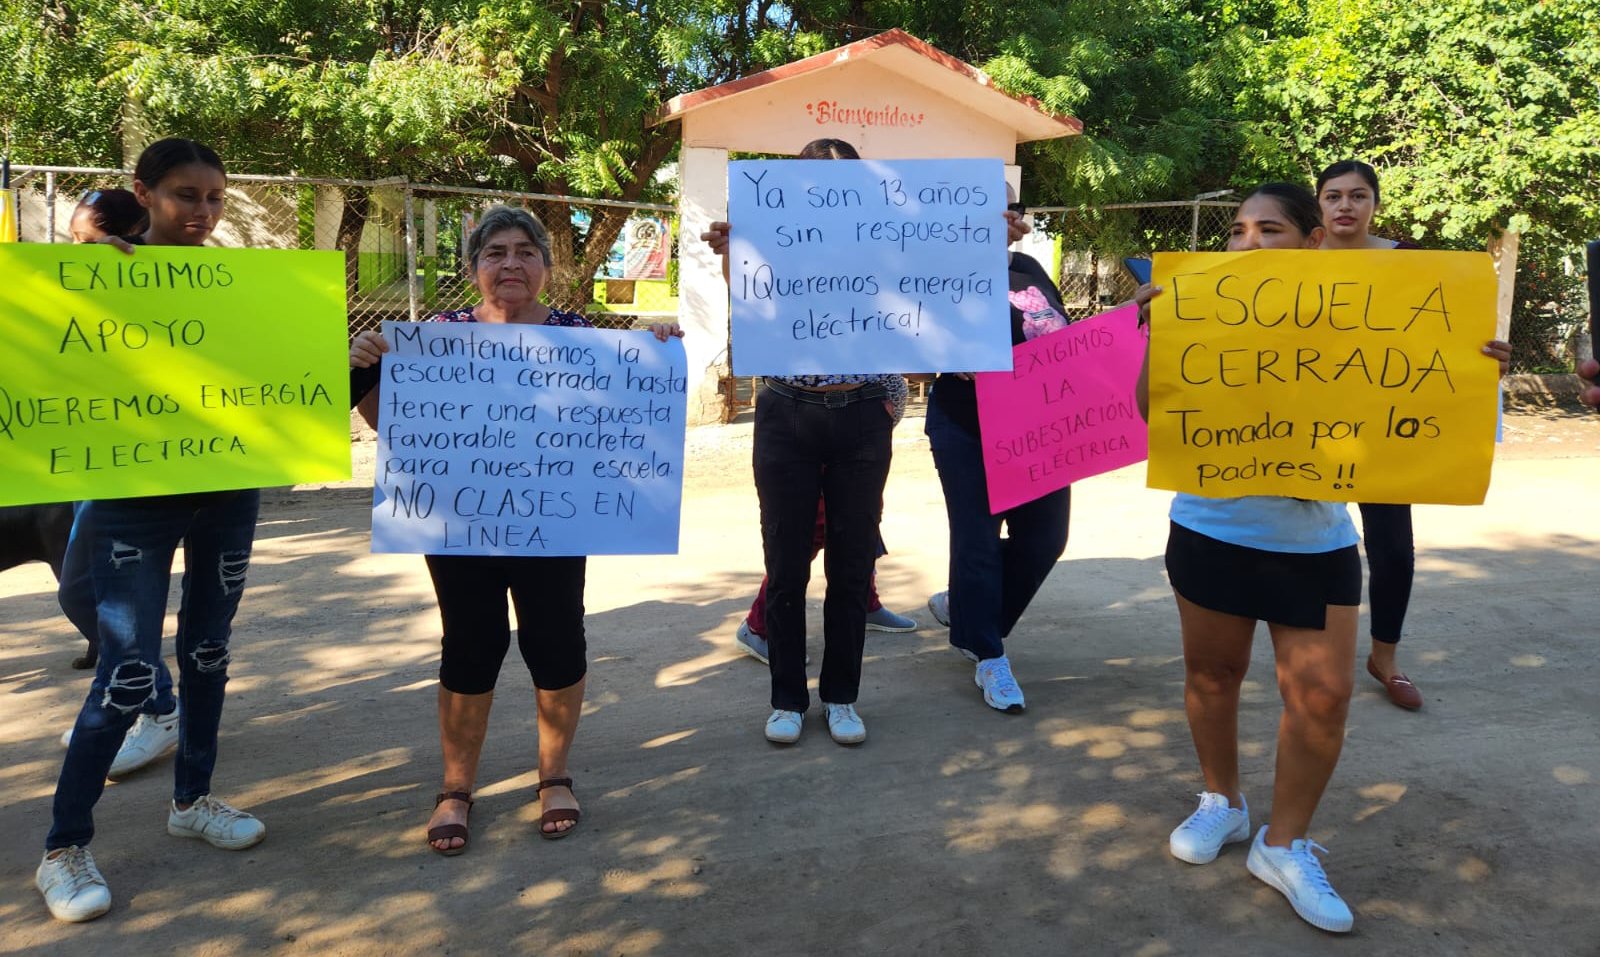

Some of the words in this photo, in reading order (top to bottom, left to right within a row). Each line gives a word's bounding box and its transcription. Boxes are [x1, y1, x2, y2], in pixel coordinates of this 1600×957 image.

[743, 170, 784, 209] Ya
[808, 186, 861, 208] son
[880, 179, 907, 206] 13
[919, 180, 988, 207] años
[777, 224, 823, 247] sin
[856, 215, 991, 252] respuesta
[59, 261, 233, 291] EXIGIMOS
[900, 272, 992, 304] energía
[792, 301, 922, 340] eléctrica!
[1172, 273, 1451, 331] ESCUELA
[60, 317, 204, 353] APOYO
[394, 326, 596, 366] Mantendremos
[618, 340, 639, 365] la
[391, 361, 494, 384] escuela
[517, 367, 611, 391] cerrada
[626, 367, 686, 394] hasta
[1180, 343, 1455, 394] CERRADA
[201, 372, 333, 409] ENERGÍA
[1043, 379, 1076, 405] LA
[388, 392, 474, 419] tener
[558, 400, 671, 439] respuesta
[995, 394, 1134, 464] SUBESTACIÓN
[1166, 410, 1293, 447] Tomada
[1311, 421, 1364, 449] por
[51, 435, 246, 474] ELECTRICA
[388, 424, 516, 450] favorable
[384, 457, 449, 484] para
[471, 454, 574, 478] nuestra
[1028, 435, 1130, 482] ELÉCTRICA
[392, 483, 435, 519] NO
[455, 486, 576, 518] CLASES
[595, 491, 635, 519] EN
[443, 517, 549, 549] LÍNEA
